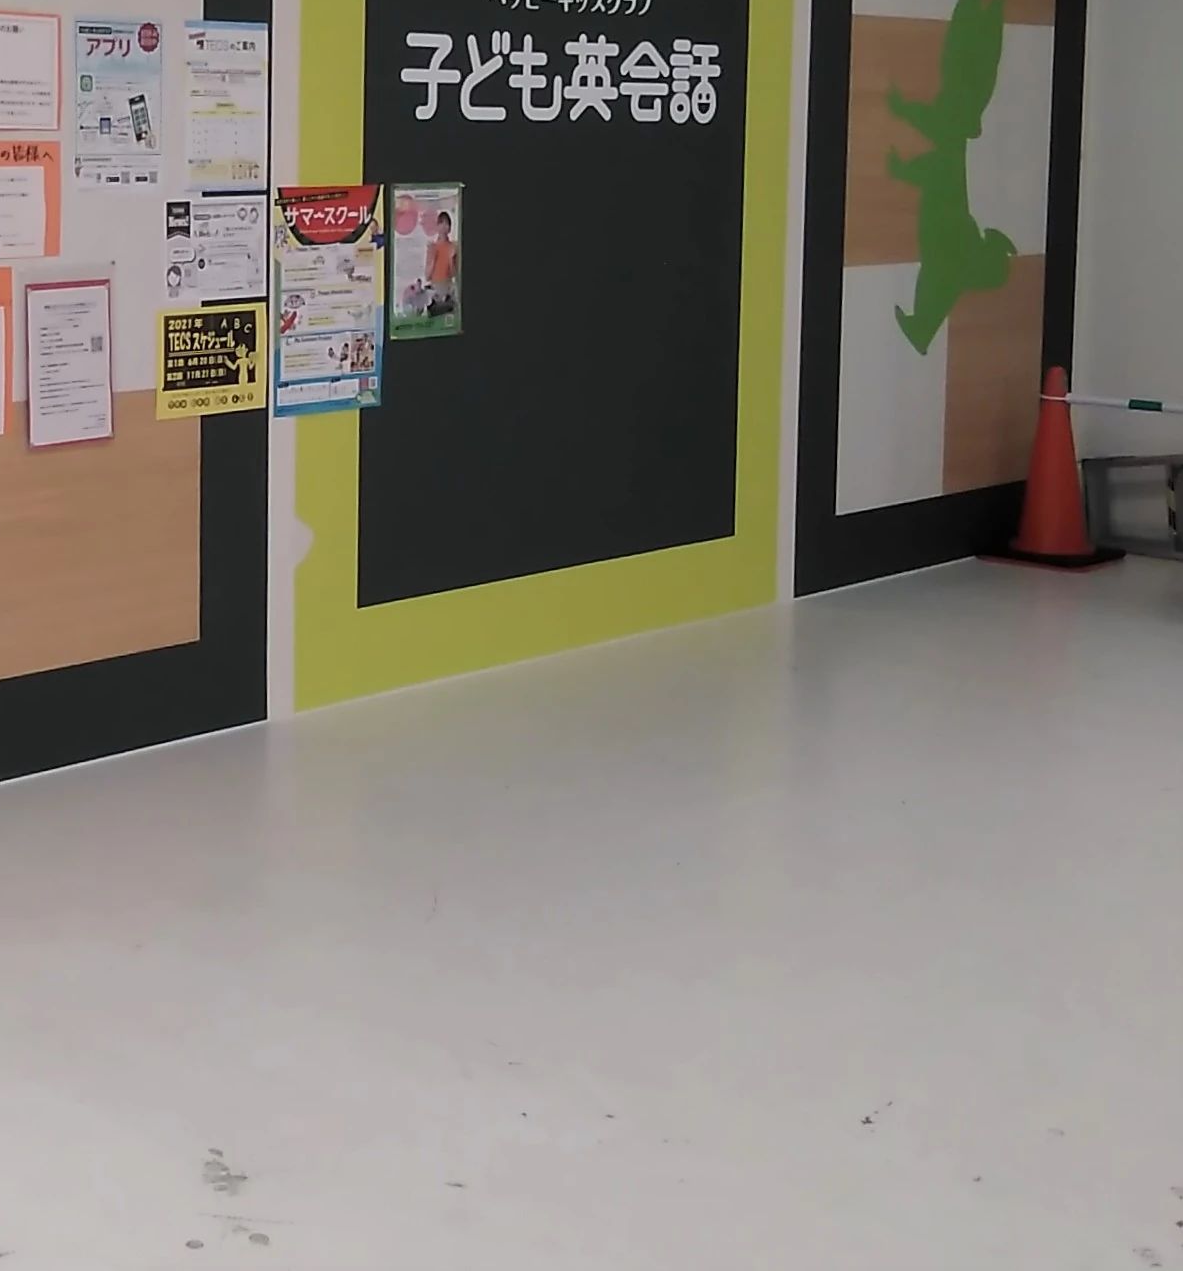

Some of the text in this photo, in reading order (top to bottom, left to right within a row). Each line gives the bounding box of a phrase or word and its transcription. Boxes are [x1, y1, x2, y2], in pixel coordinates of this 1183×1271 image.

[86, 36, 131, 58] アプリ
[400, 31, 721, 124] 子ども英会話
[284, 206, 372, 227] サマースクール
[168, 318, 203, 330] 2021年
[221, 318, 252, 334] A B C
